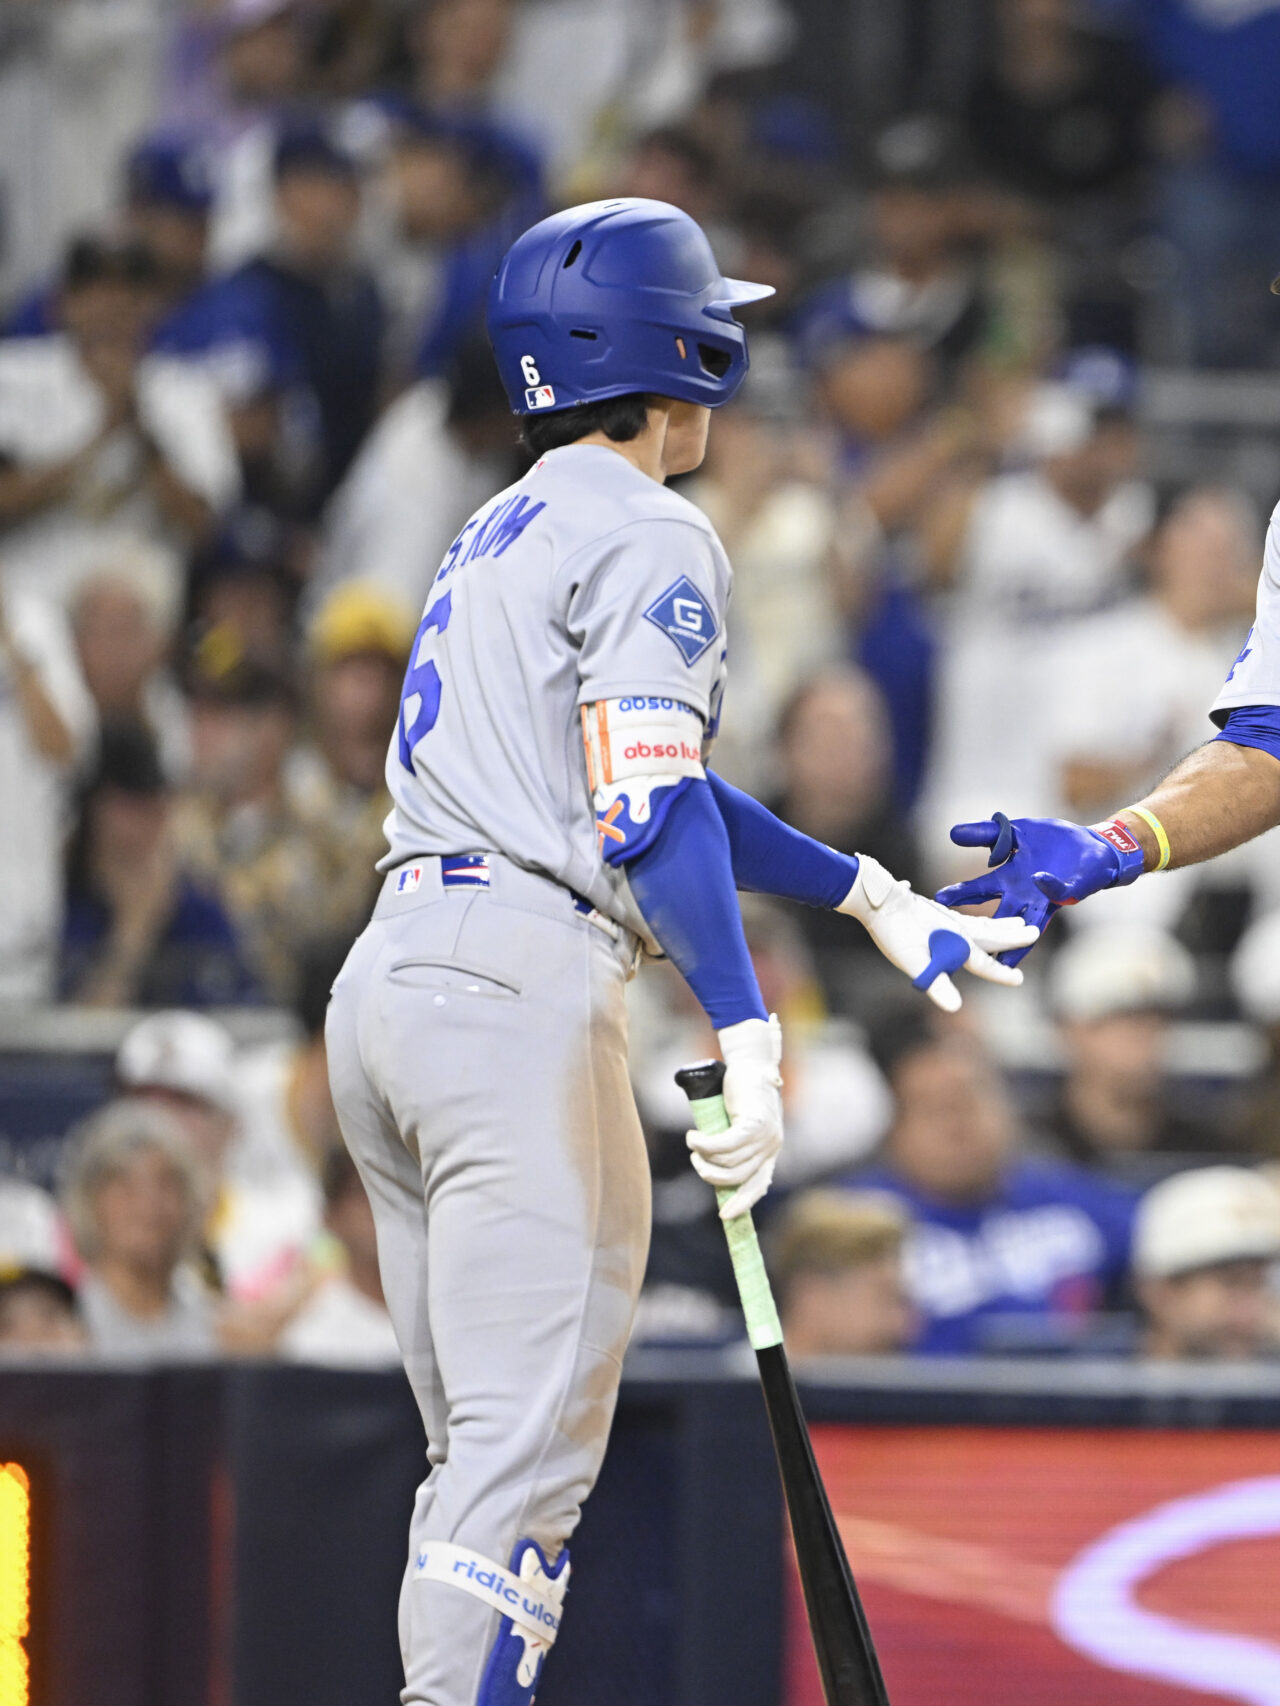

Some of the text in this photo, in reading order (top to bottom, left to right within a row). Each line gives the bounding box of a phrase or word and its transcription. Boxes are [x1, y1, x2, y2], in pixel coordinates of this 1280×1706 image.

[520, 354, 541, 387] 6
[672, 597, 703, 632] G
[399, 587, 453, 778] 6
